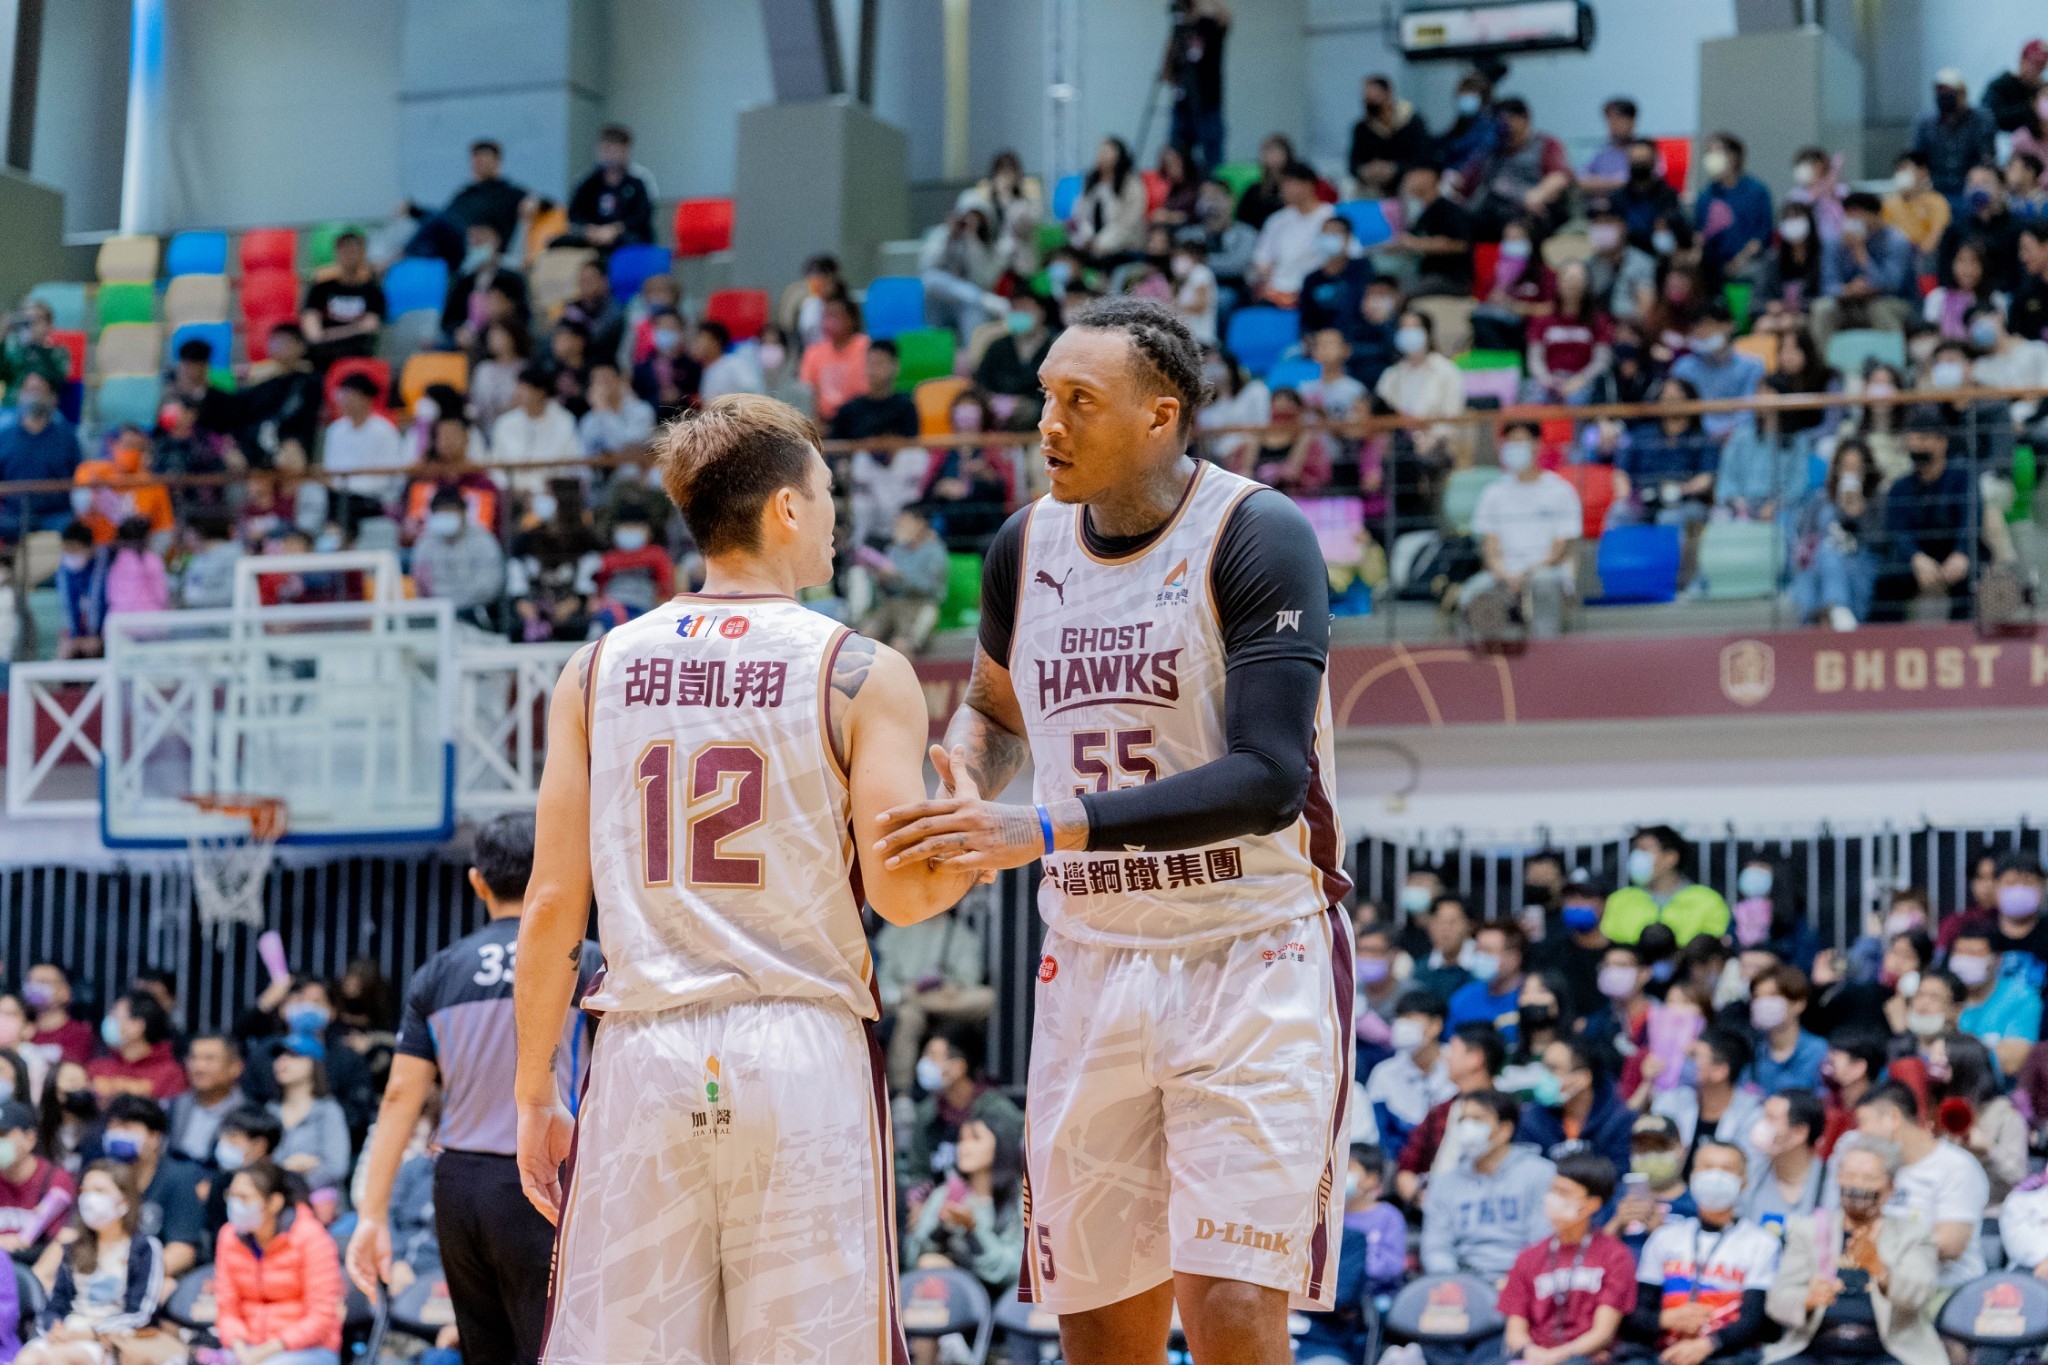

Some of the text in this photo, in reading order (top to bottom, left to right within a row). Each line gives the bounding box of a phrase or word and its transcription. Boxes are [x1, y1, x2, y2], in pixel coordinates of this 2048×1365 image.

[1061, 621, 1154, 654] GHOST
[625, 657, 788, 709] 胡凱翔
[1034, 647, 1185, 711] HAWKS
[1814, 644, 2002, 692] GHOST
[1070, 727, 1160, 798] 55
[634, 739, 769, 890] 12
[1195, 1217, 1291, 1255] D-Link
